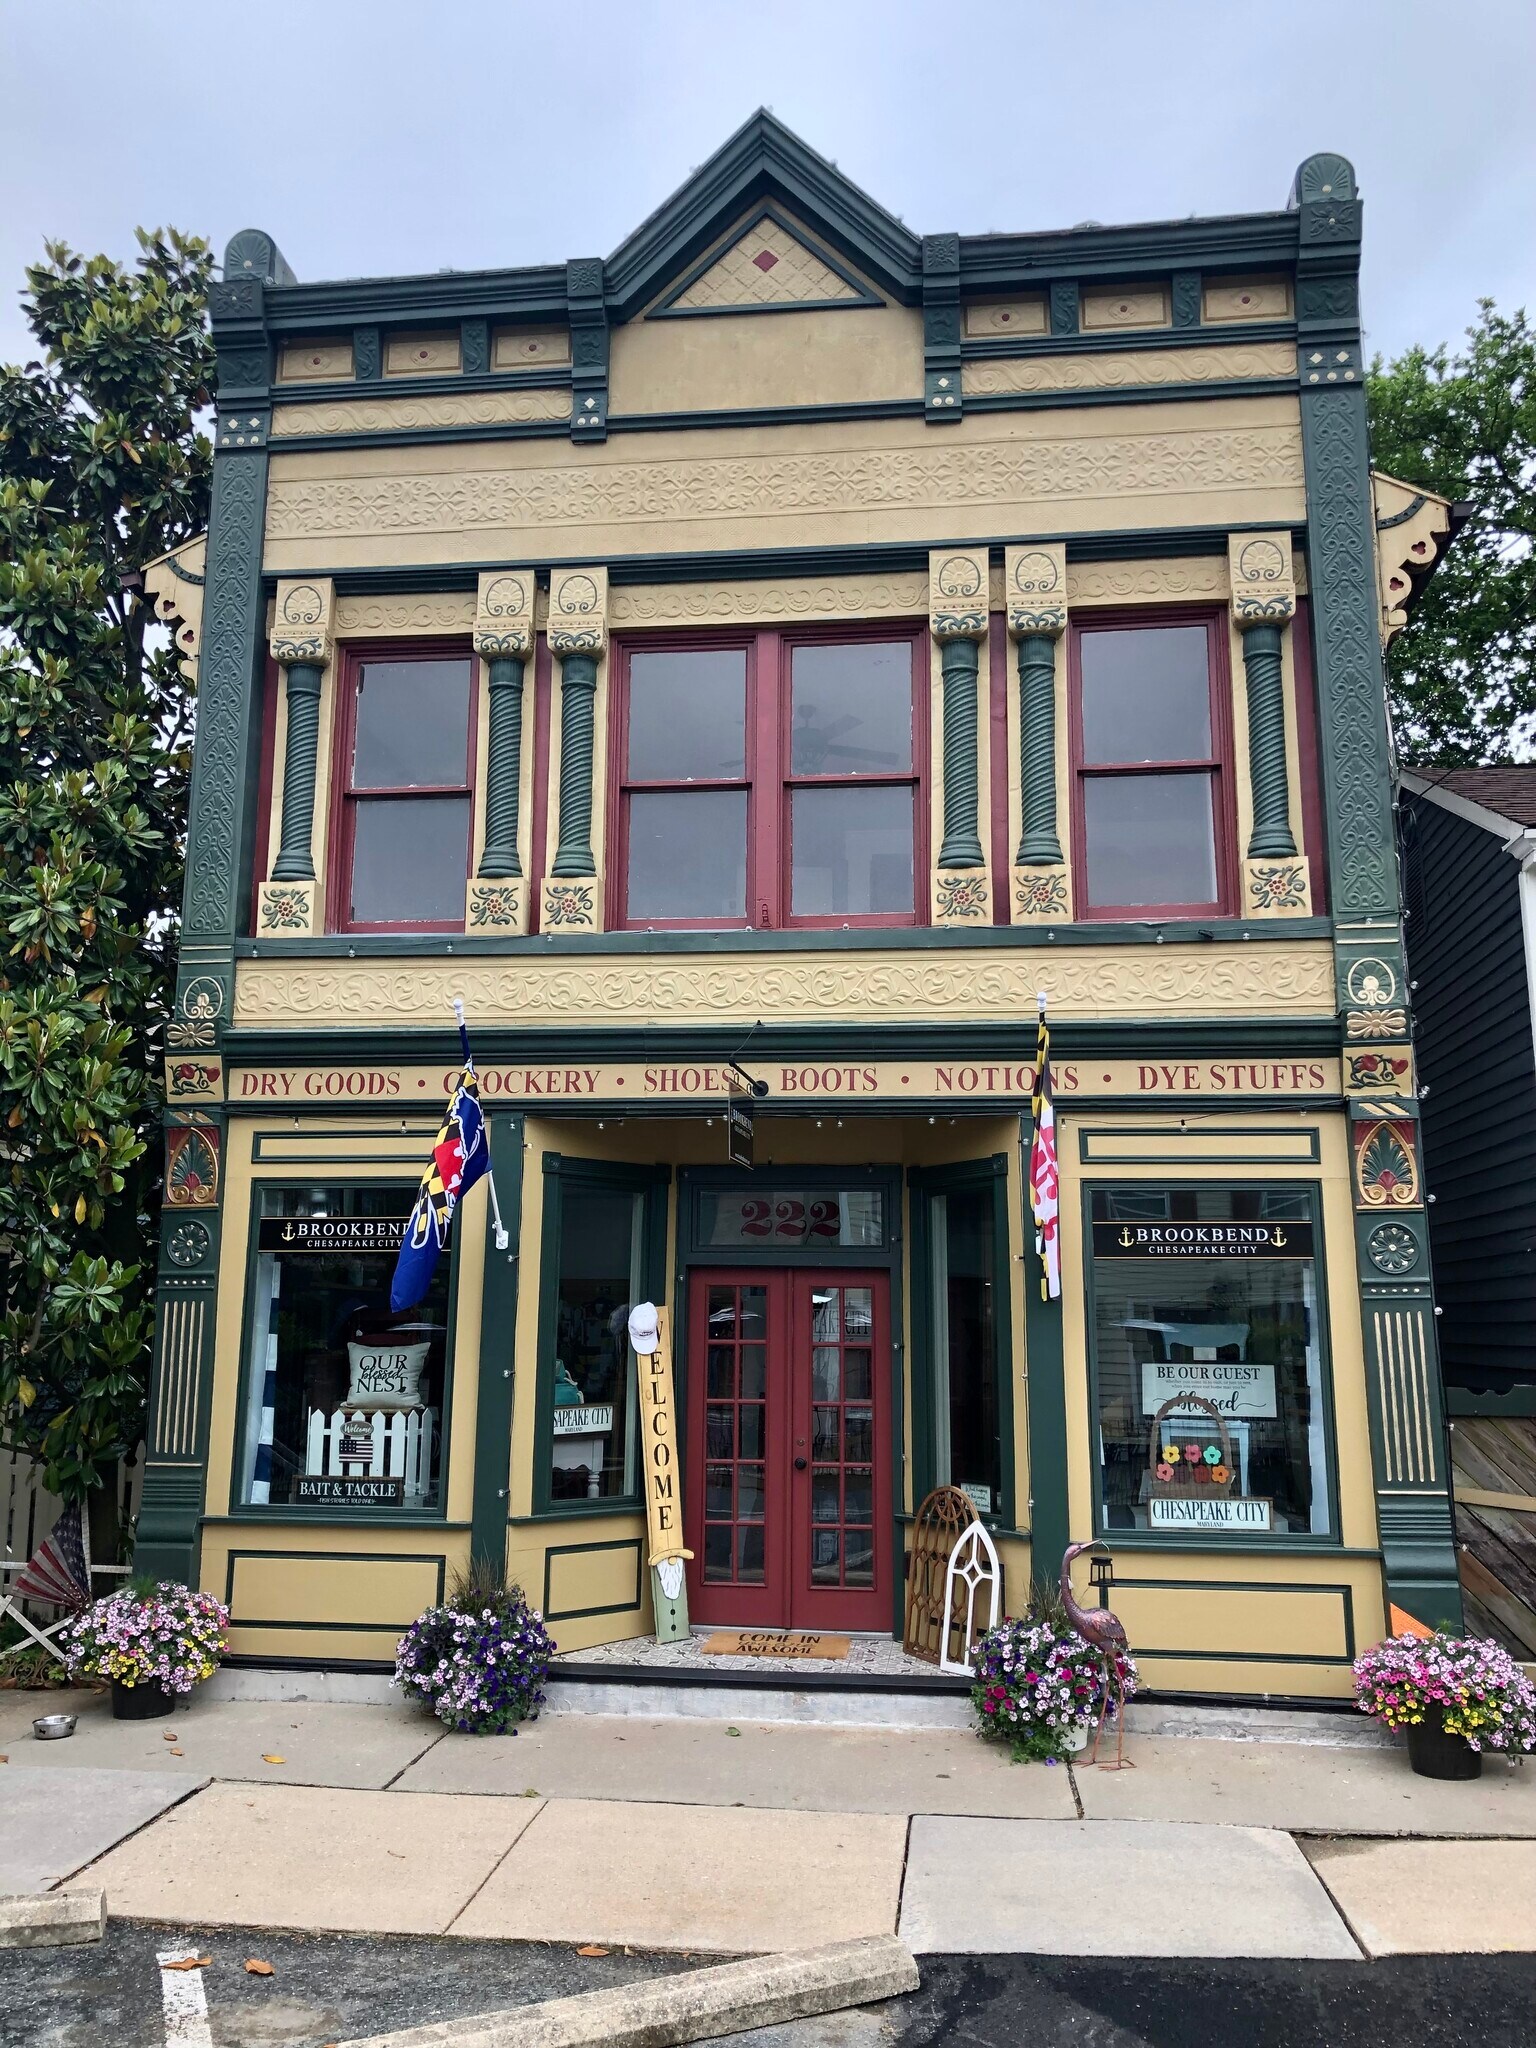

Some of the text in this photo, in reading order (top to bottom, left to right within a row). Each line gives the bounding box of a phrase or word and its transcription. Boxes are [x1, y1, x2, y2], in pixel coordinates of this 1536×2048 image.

[241, 1072, 297, 1096] DRY
[304, 1071, 400, 1096] GOODS
[443, 1069, 602, 1094] COCKERY
[643, 1067, 742, 1092] SHOES
[780, 1066, 878, 1092] BOOTS
[1137, 1065, 1201, 1090] DYE
[1209, 1064, 1325, 1090] STUFFS
[741, 1200, 841, 1237] 222
[1136, 1228, 1269, 1242] BROOKBEND
[307, 1239, 401, 1248] CHESAPEAKE CITY
[1148, 1246, 1258, 1254] CHESAPEAKE CITY
[359, 1354, 408, 1371] OUR
[1157, 1366, 1261, 1380] BE OUR GUEST
[355, 1376, 409, 1394] NEST
[591, 1407, 611, 1425] CITY
[300, 1481, 396, 1497] BAIT & TACKLE
[1152, 1500, 1266, 1522] CHESAPEAKE CITY
[738, 1633, 821, 1644] COME IN
[736, 1645, 815, 1654] AWESOME
